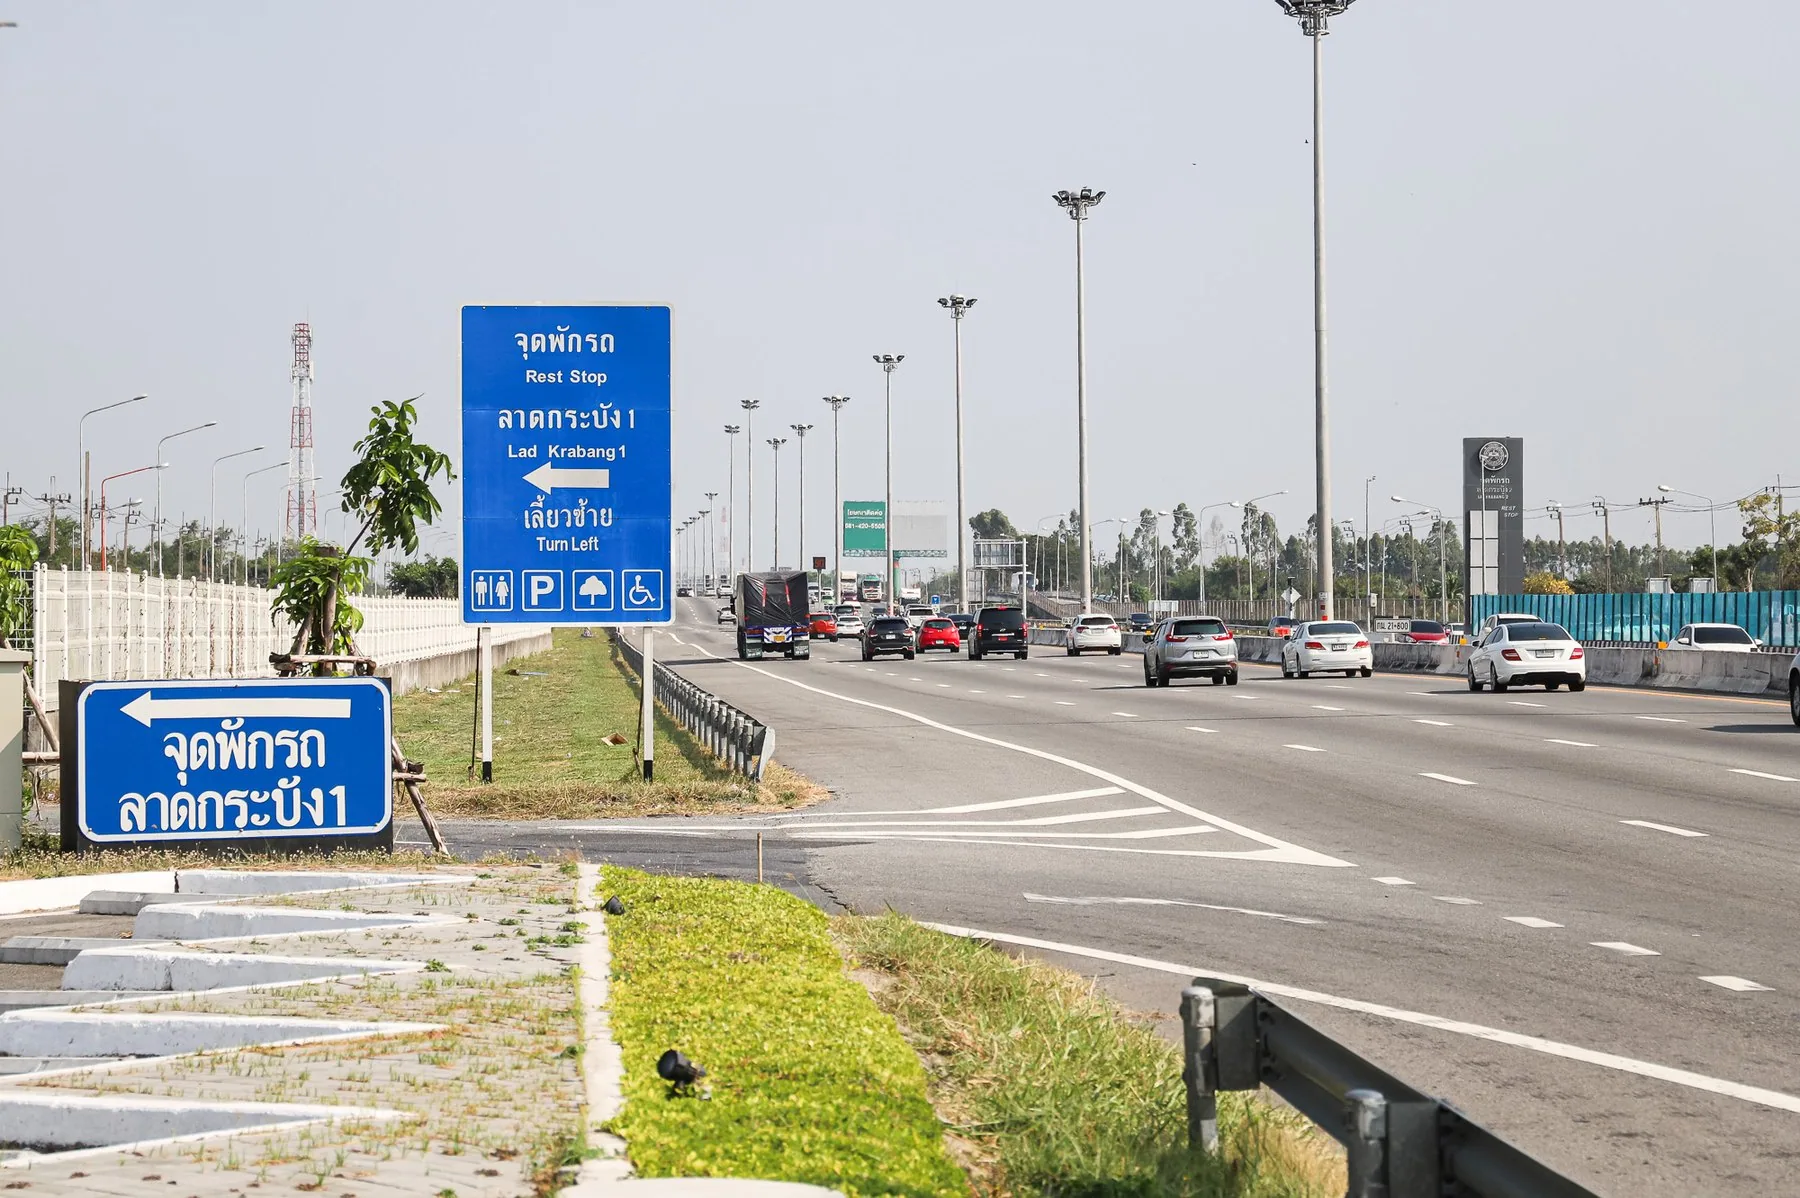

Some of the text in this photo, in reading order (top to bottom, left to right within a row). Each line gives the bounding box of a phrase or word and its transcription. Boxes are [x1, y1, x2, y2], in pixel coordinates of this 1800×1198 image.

[514, 325, 615, 361] จุดพักรถ
[526, 369, 608, 387] Rest Stop
[498, 402, 636, 430] ลาดกระบัง 1
[508, 444, 627, 462] Lad Krabang 1
[523, 495, 613, 529] เลี้ยวซ้าย
[536, 536, 599, 552] Turn Left
[530, 575, 555, 606] P
[162, 717, 326, 787] จุดพักรถ
[118, 774, 348, 833] ลาดกระบัง 1
